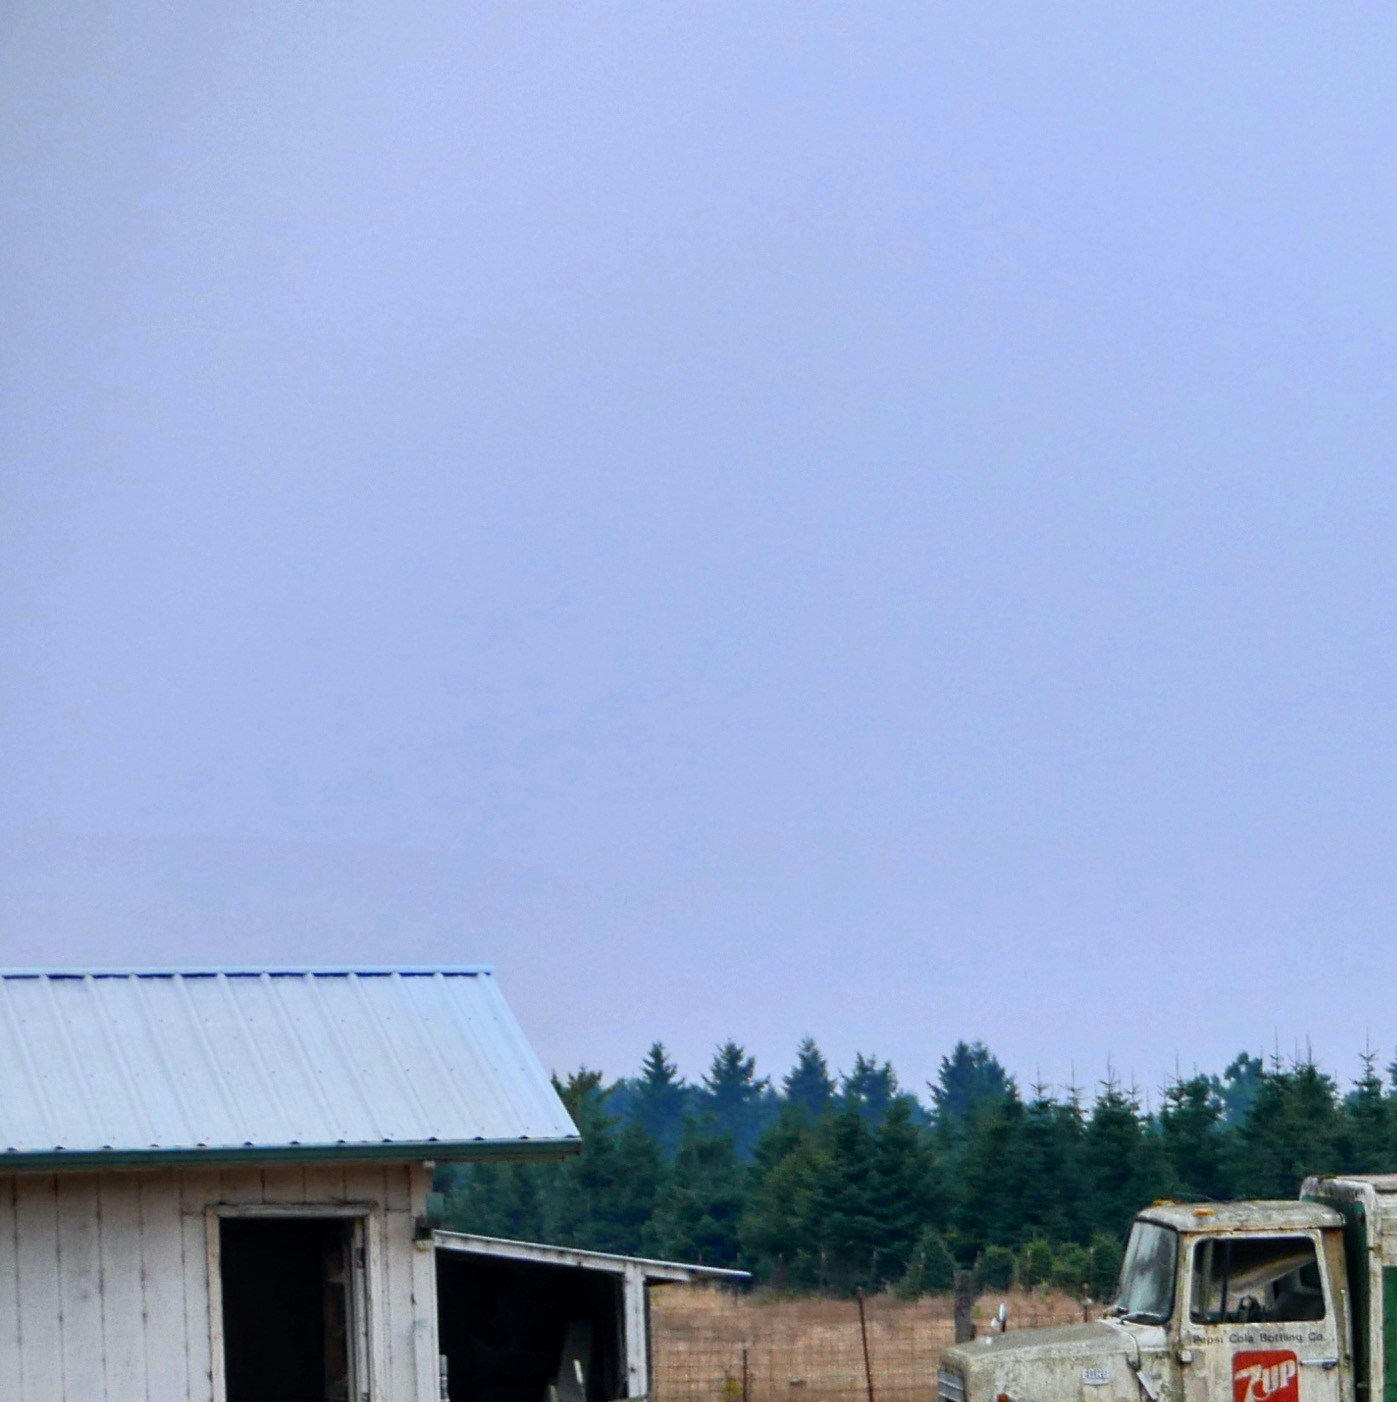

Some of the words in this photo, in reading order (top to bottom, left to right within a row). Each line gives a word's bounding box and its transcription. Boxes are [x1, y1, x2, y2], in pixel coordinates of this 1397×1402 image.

[1192, 1334, 1224, 1345] Pepsi
[1228, 1332, 1254, 1344] Cola
[1259, 1331, 1303, 1344] Bottling
[1081, 1368, 1111, 1380] FORD
